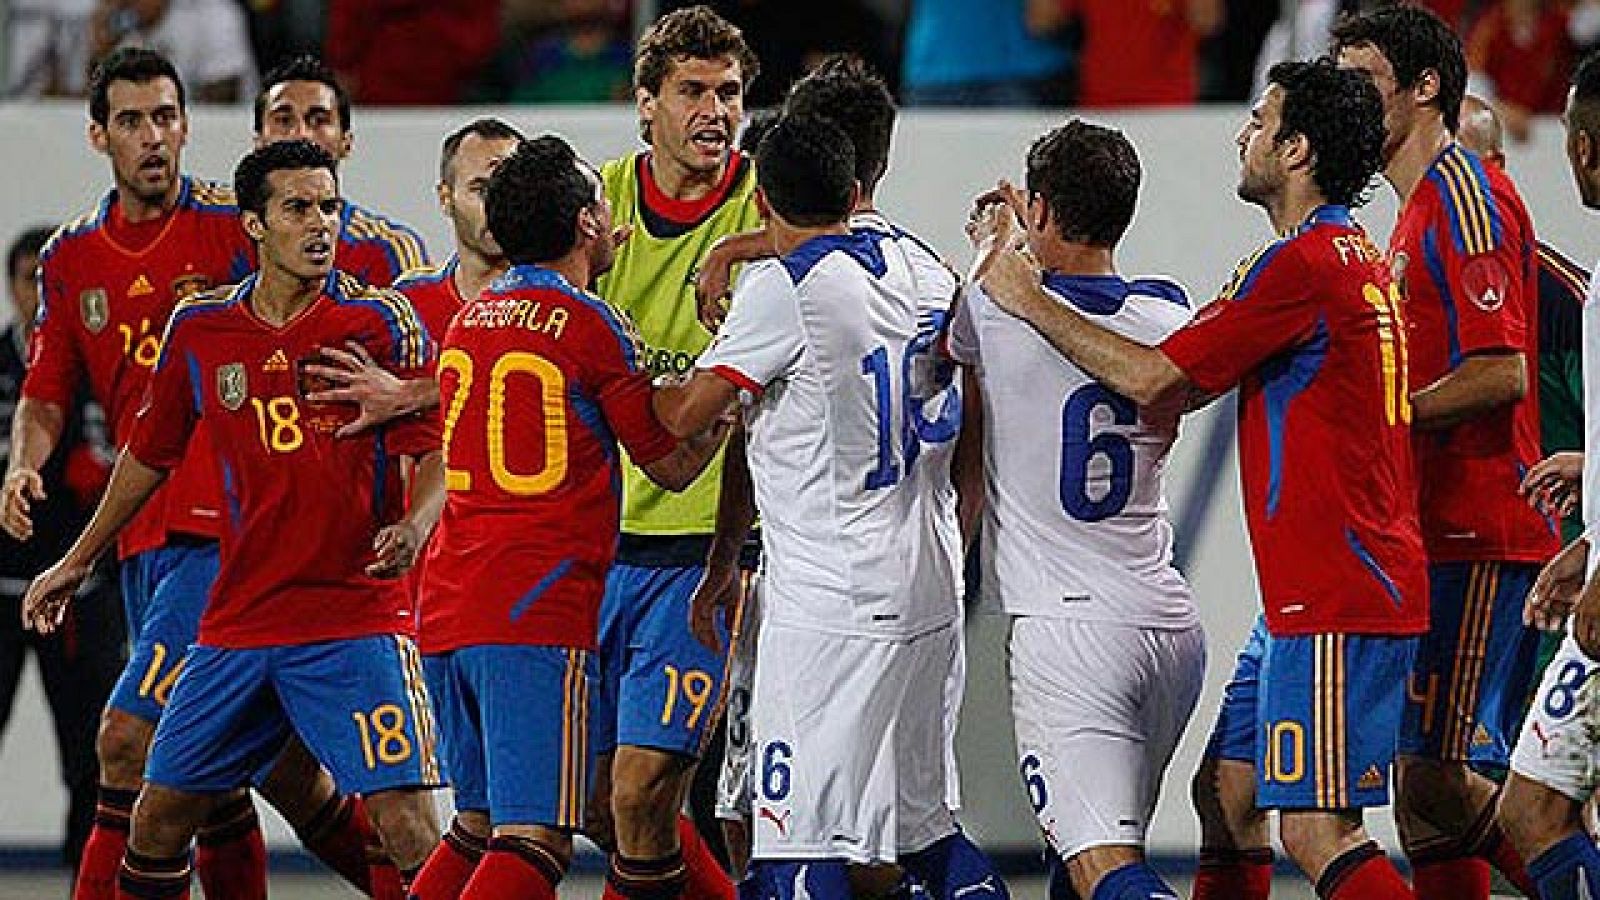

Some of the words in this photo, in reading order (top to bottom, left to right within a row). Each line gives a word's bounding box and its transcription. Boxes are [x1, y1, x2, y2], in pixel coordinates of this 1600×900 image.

[119, 317, 161, 367] 16
[252, 396, 304, 455] 18
[440, 349, 568, 495] 20
[1060, 383, 1138, 522] 6
[661, 664, 713, 730] 19
[1407, 671, 1441, 737] 4
[1544, 659, 1587, 718] 8
[352, 704, 411, 769] 18
[1264, 721, 1304, 783] 10
[1020, 754, 1048, 815] 6
